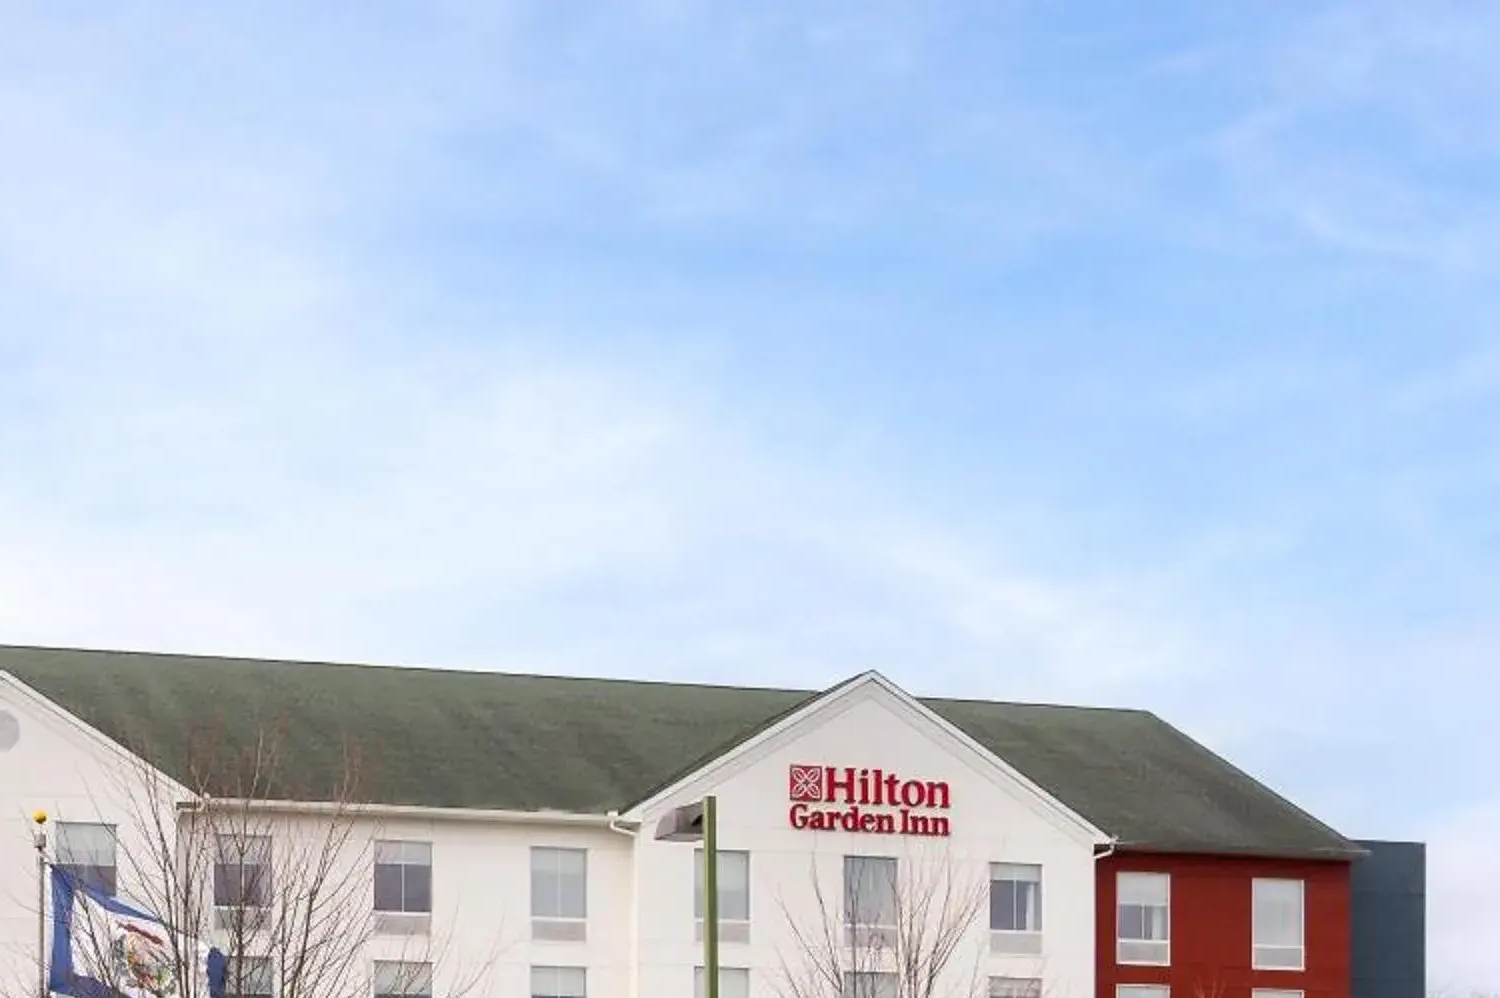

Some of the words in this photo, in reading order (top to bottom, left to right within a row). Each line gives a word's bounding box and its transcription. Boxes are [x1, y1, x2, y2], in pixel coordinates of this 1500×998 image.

[824, 766, 951, 809] Hilton
[789, 803, 896, 834] Garden
[900, 809, 951, 837] Inn
